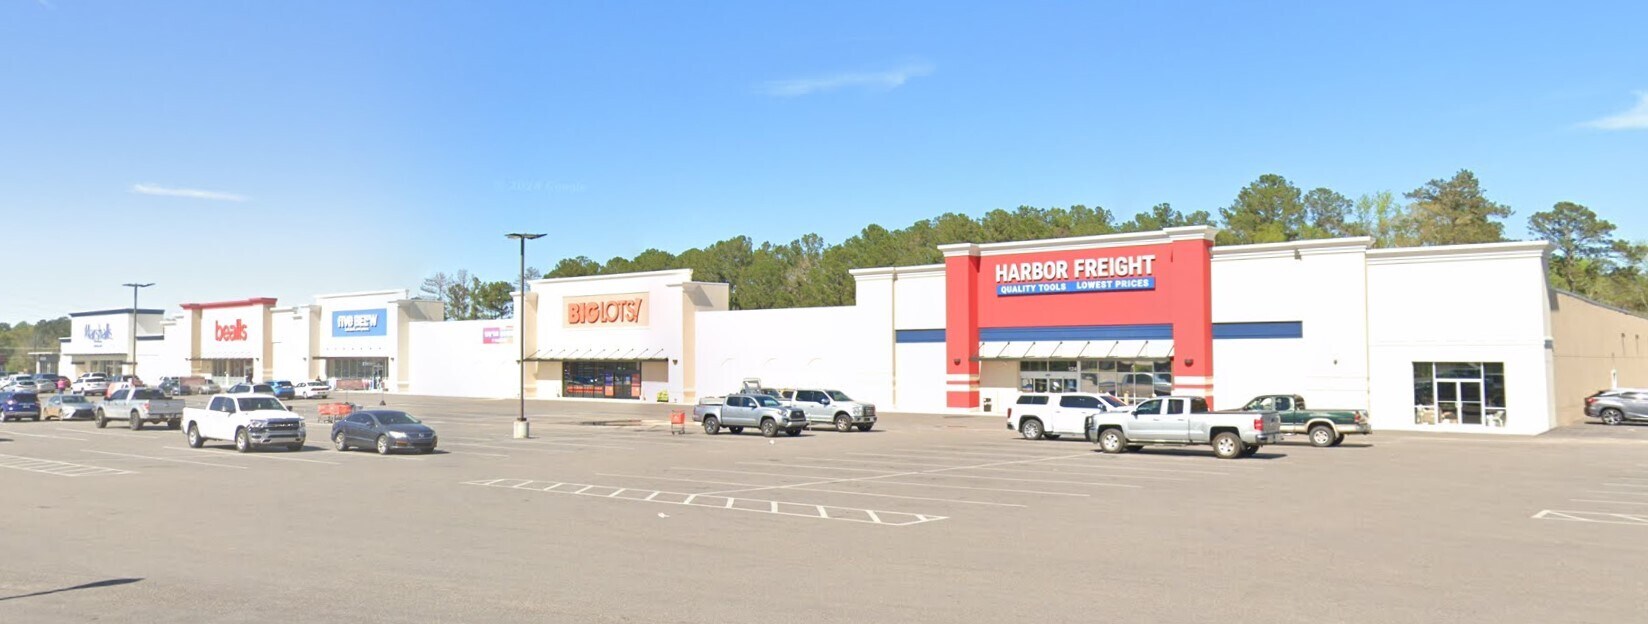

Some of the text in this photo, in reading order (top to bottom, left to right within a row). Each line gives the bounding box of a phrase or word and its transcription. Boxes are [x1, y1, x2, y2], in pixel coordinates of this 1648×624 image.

[995, 255, 1156, 283] HARBOR FREIGHT
[1000, 278, 1149, 294] QUALITY TOOLS LOWEST PRICES
[568, 302, 600, 324] BIG
[215, 318, 247, 341] bealls
